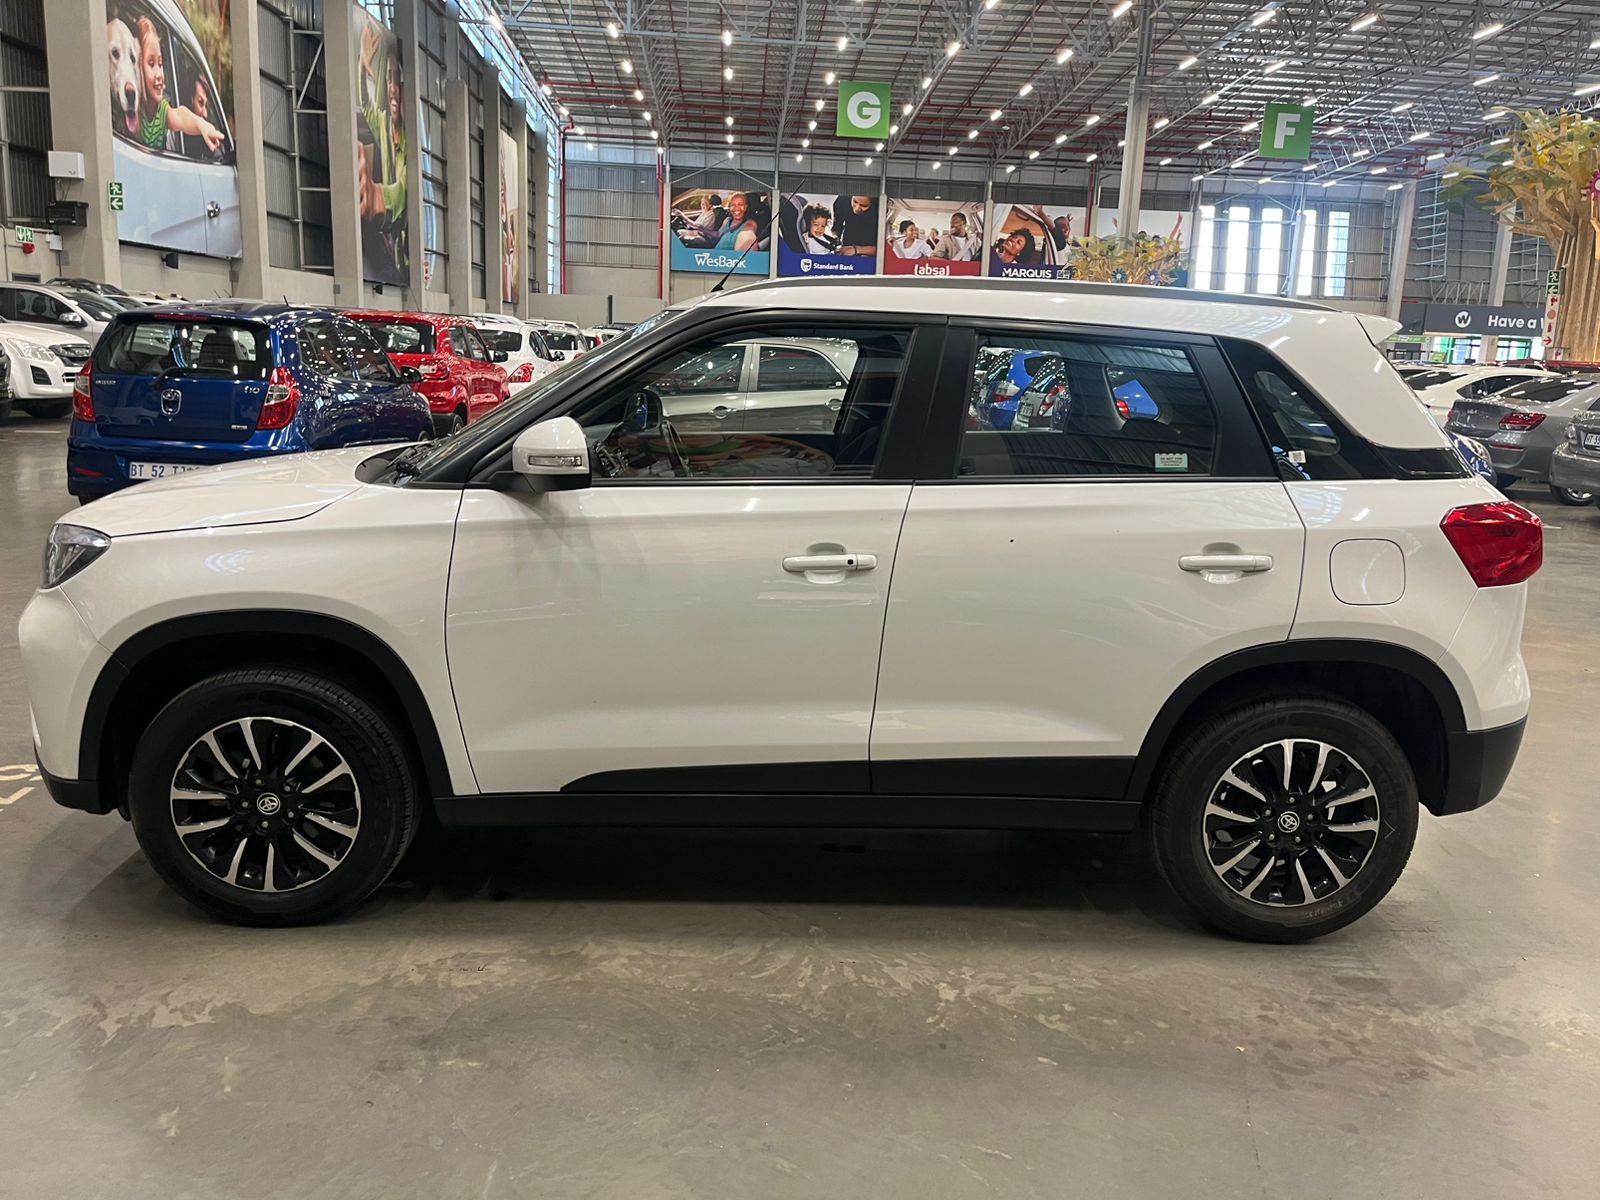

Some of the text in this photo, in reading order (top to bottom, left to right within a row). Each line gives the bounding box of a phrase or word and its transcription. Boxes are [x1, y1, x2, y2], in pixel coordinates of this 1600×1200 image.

[847, 91, 881, 129] G
[1273, 112, 1301, 149] F
[694, 252, 746, 269] WesBank
[813, 263, 854, 271] Standard Bank
[1002, 267, 1052, 279] MARQUIS
[1487, 314, 1524, 329] Have
[1527, 317, 1537, 329] a
[130, 464, 145, 477] BT
[151, 464, 165, 478] 52
